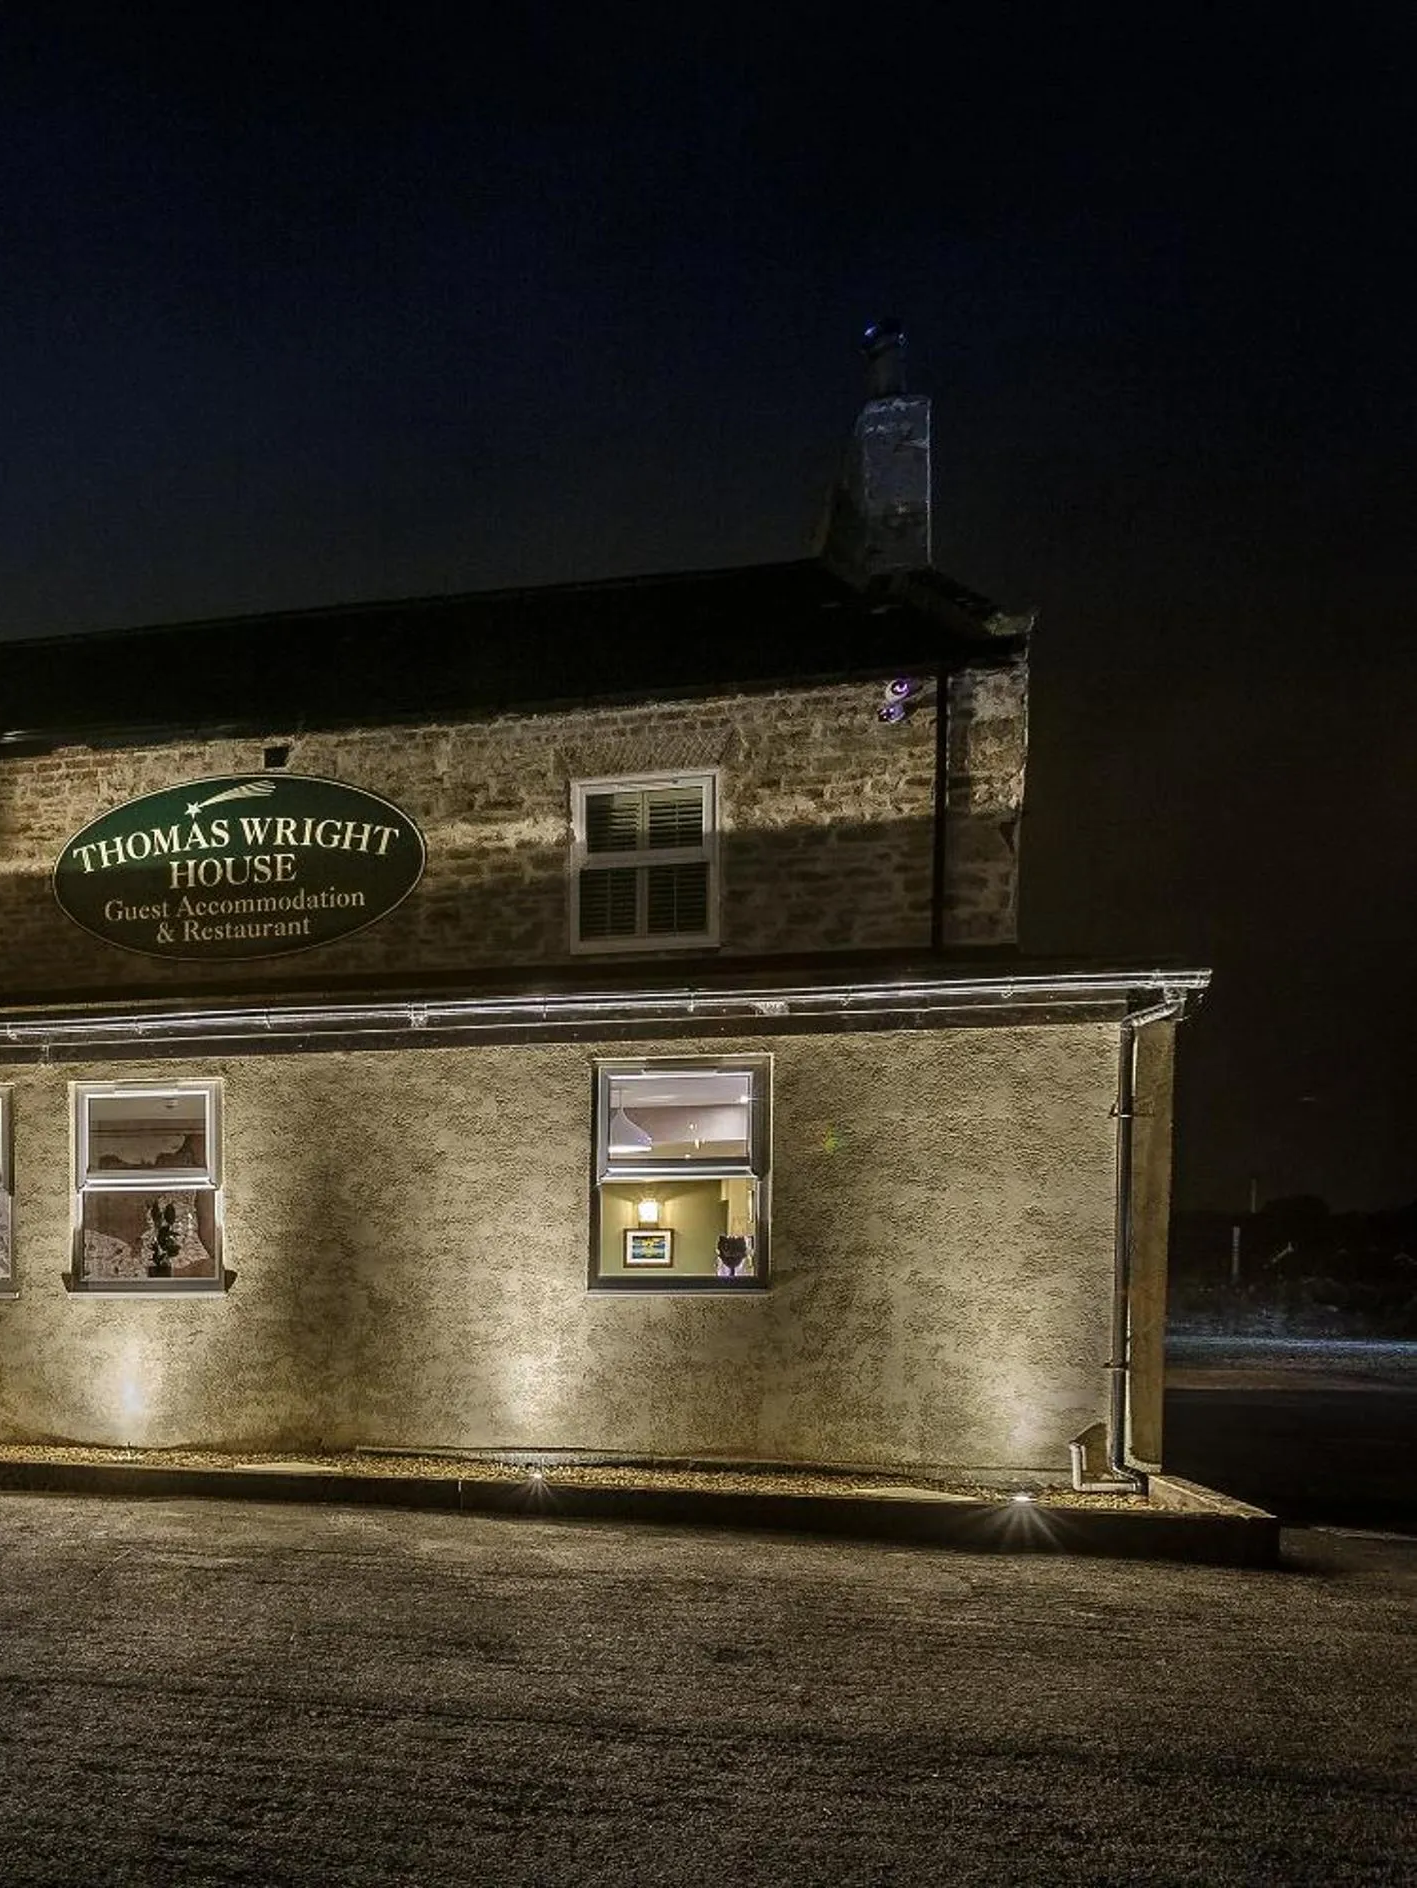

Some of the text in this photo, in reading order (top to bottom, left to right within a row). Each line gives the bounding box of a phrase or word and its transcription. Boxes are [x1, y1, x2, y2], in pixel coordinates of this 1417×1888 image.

[72, 816, 400, 874] THOMAS WRIGHT
[168, 853, 298, 890] HOUSE
[104, 886, 366, 922] Guest Accommodation
[155, 915, 311, 944] & Restaurant
